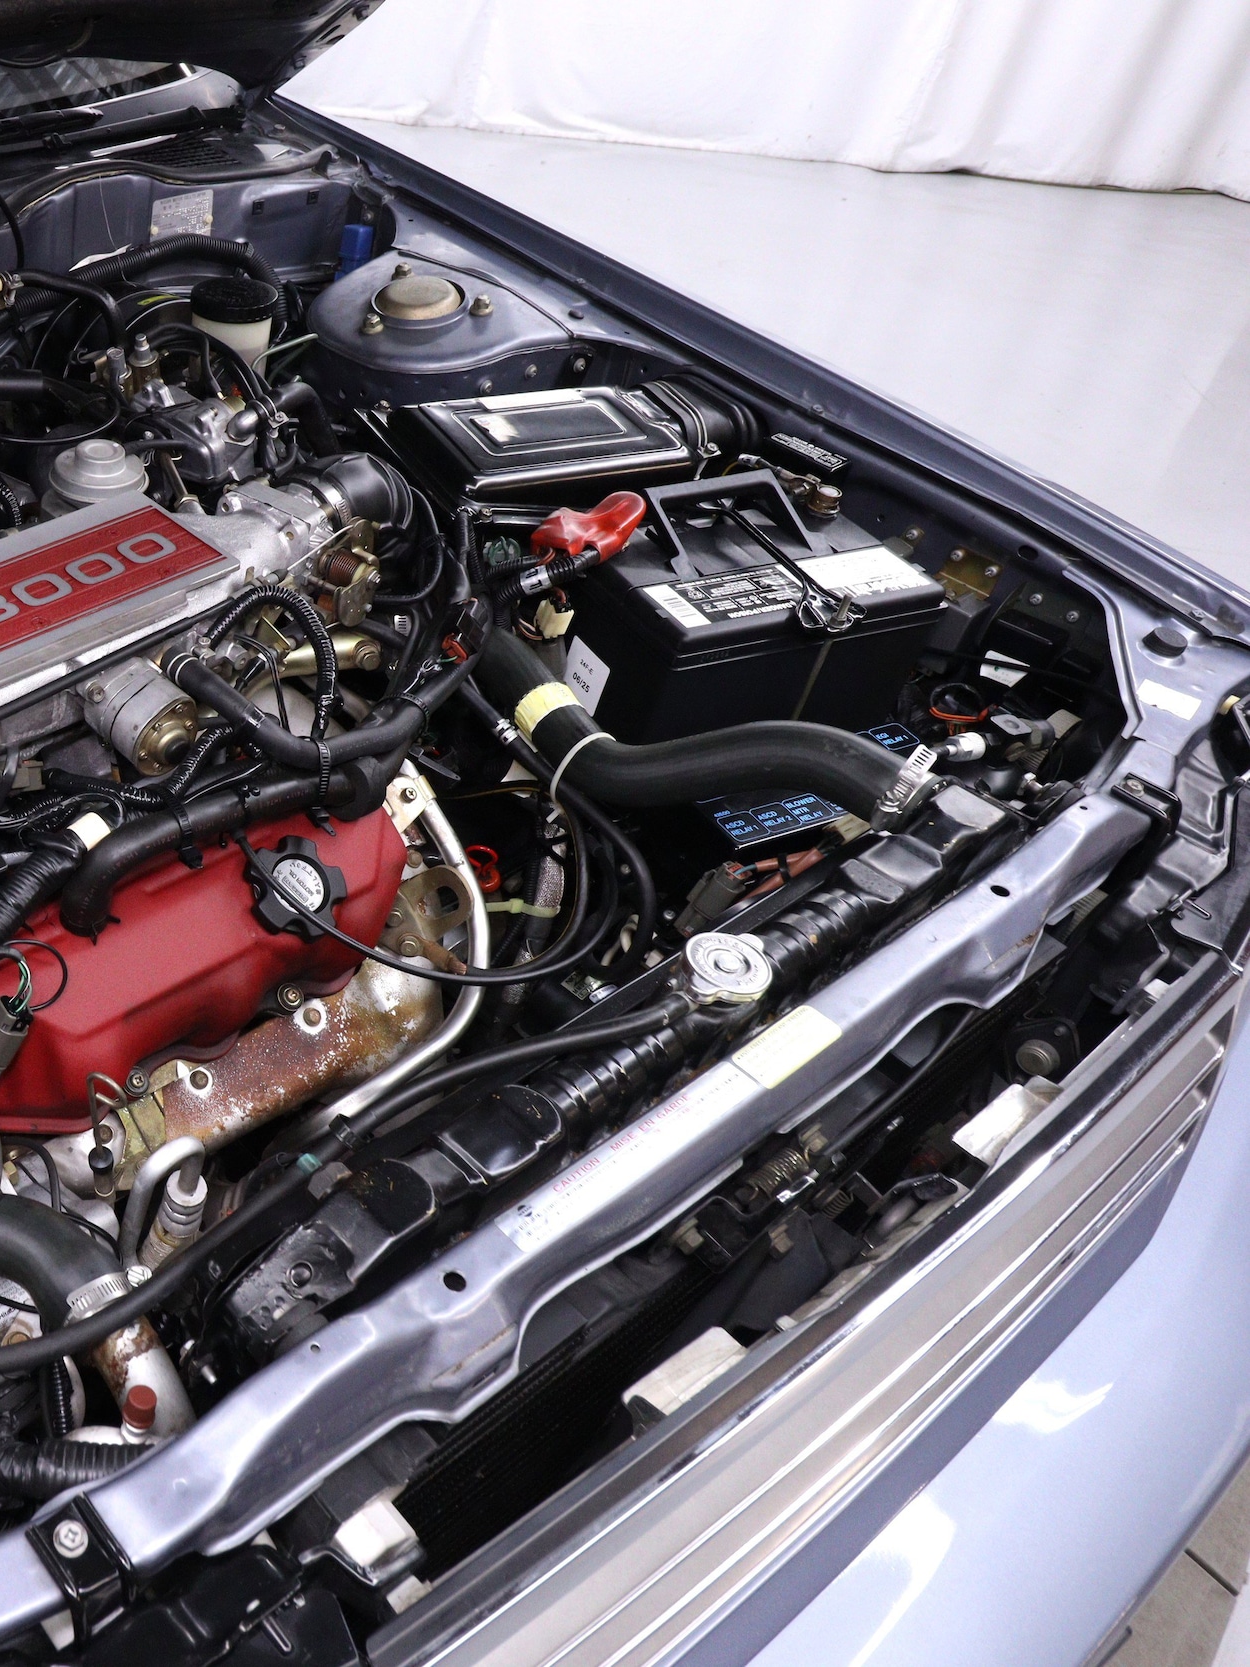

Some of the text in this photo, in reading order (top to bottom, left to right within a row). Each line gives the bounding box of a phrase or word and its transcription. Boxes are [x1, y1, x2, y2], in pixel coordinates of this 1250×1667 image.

[572, 672, 590, 693] 06/25
[882, 735, 904, 745] RELAY
[785, 796, 817, 809] BLOWER
[757, 811, 778, 821] ASCD
[791, 807, 810, 816] MTR
[798, 811, 824, 822] RELAY
[724, 820, 746, 830] ASCD
[763, 818, 786, 828] RELAY
[730, 827, 753, 837] RELAY
[551, 1093, 692, 1194] CAUTION MISE EN GARDE
